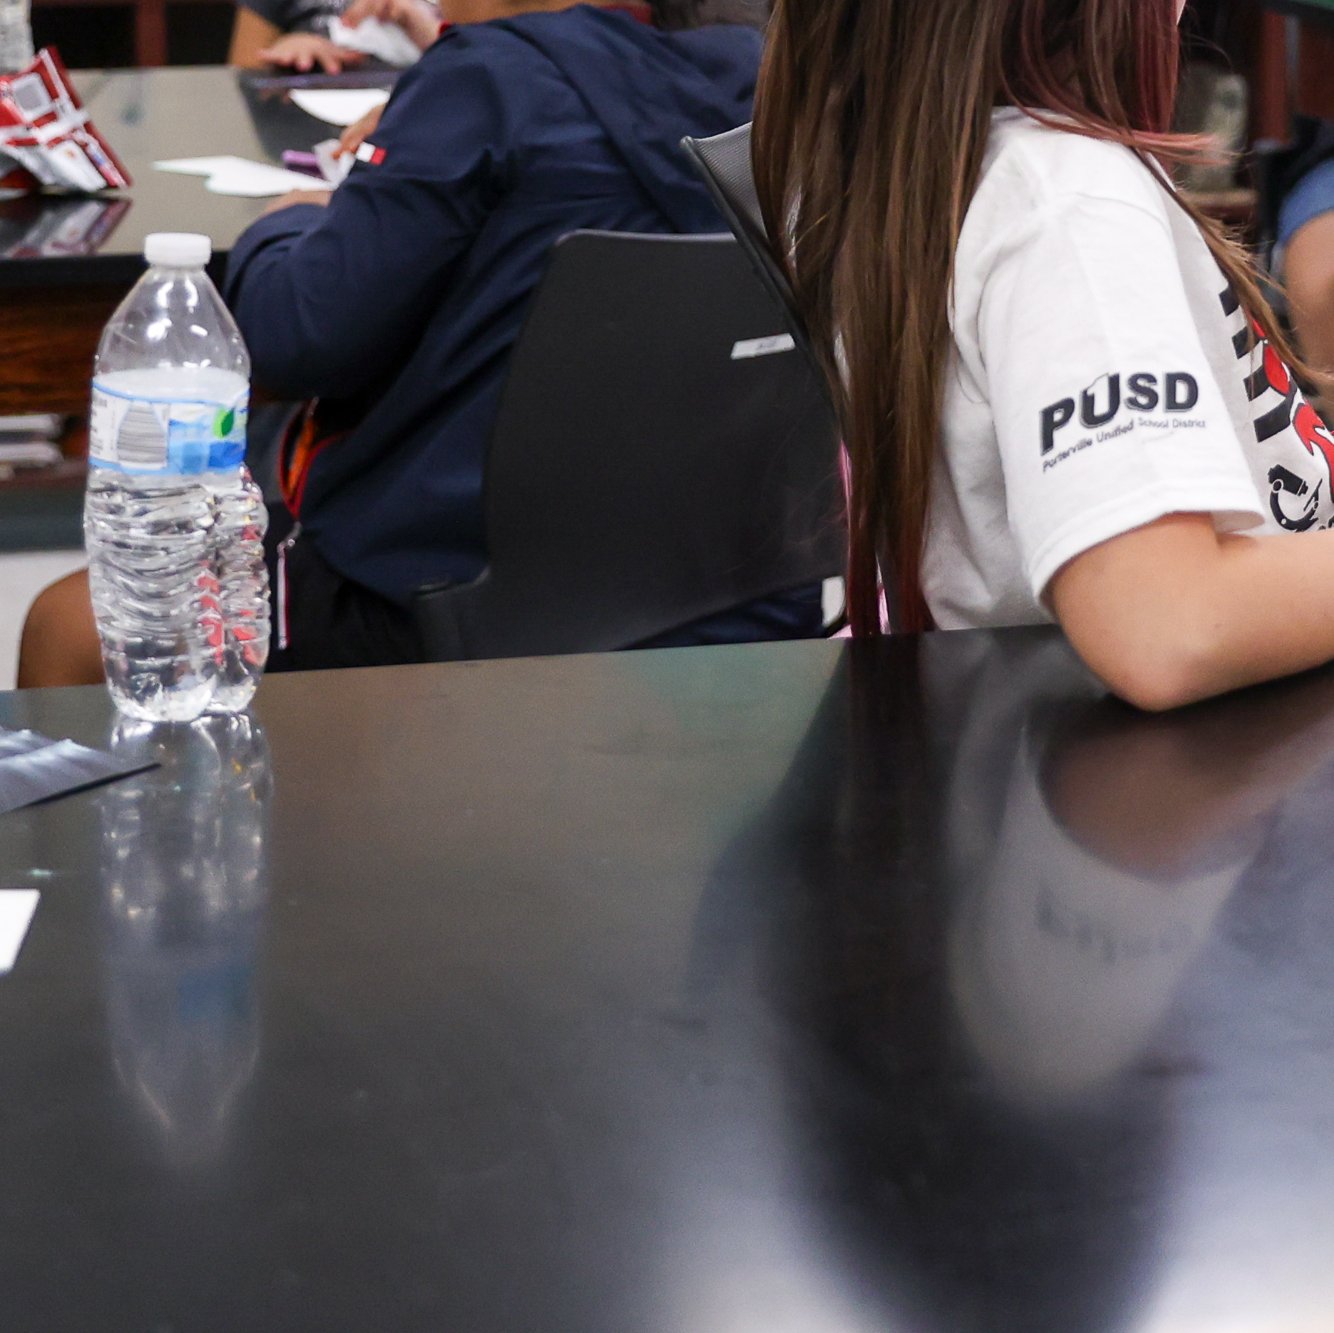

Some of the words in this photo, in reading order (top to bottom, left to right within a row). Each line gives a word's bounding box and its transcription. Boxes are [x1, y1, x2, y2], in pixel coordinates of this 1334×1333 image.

[1039, 371, 1199, 456] PUSD
[1042, 437, 1094, 473] Porterville
[1096, 418, 1135, 444] Unified
[1138, 417, 1169, 429] School
[1172, 418, 1207, 429] District
